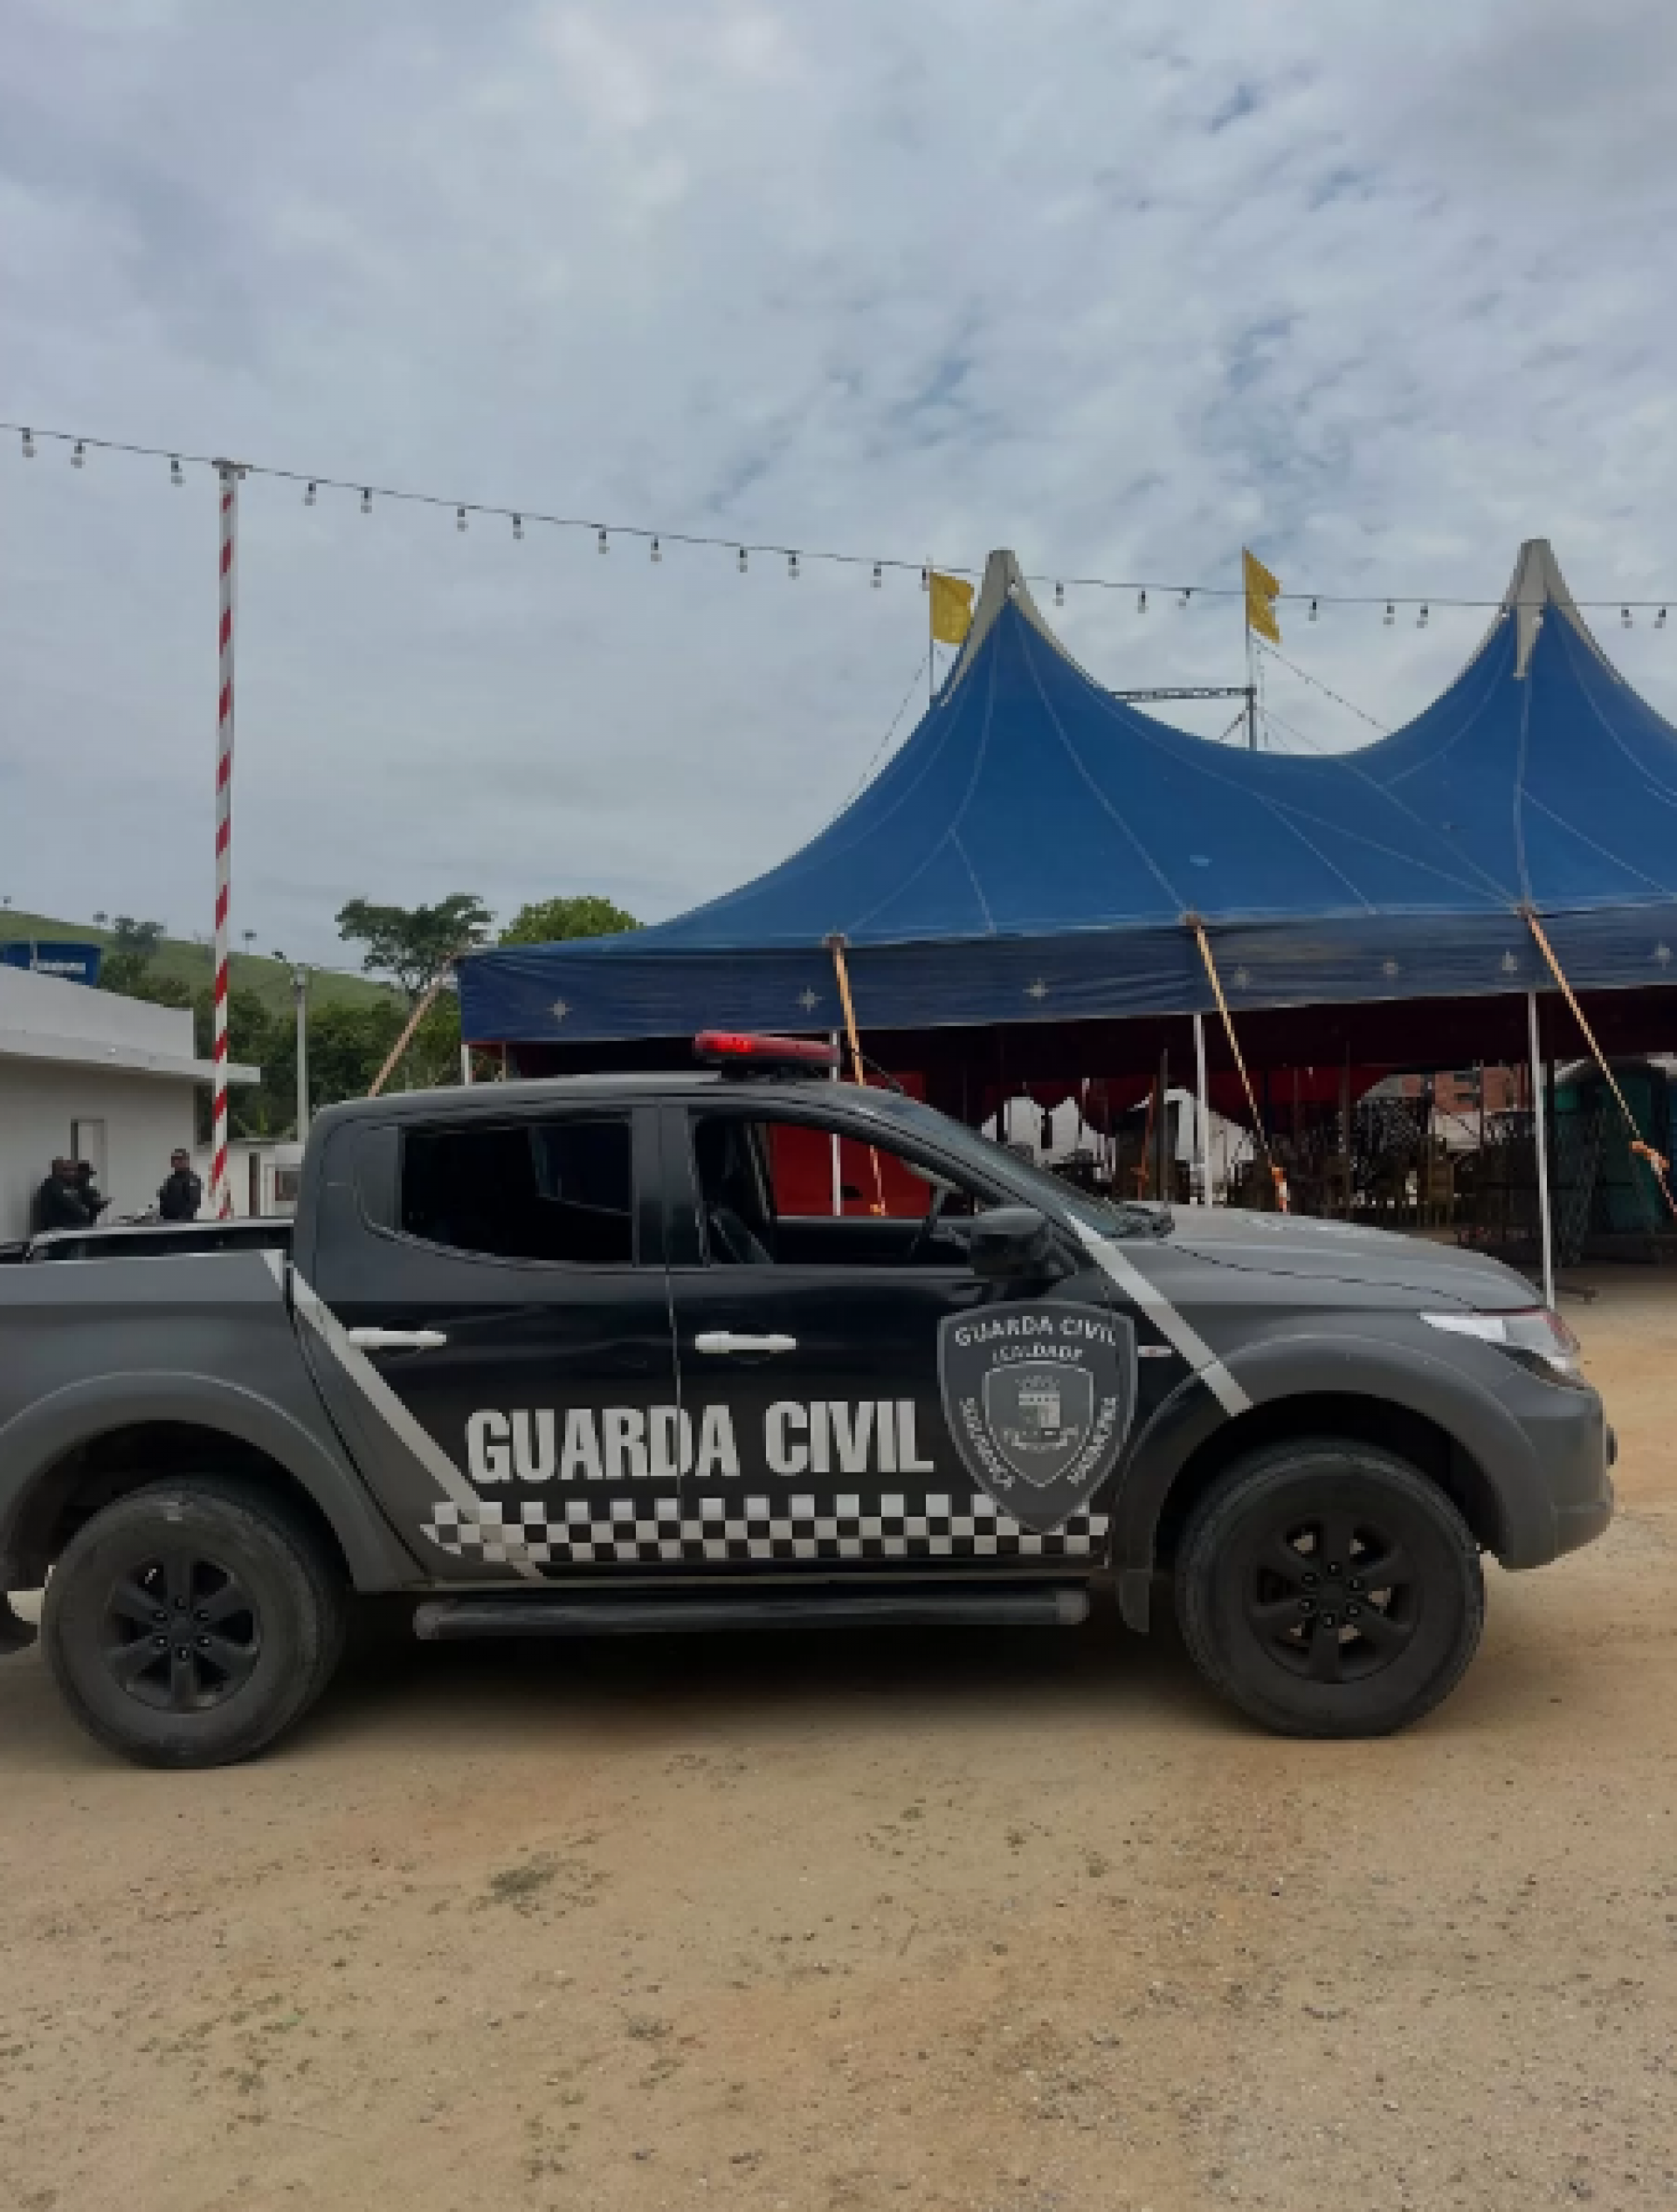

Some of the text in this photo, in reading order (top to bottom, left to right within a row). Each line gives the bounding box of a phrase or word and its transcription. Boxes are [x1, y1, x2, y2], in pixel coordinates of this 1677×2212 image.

[955, 1315, 1116, 1347] GUARDA CIVIL
[466, 1405, 741, 1484] GUARDA
[764, 1399, 935, 1476] CIVIL
